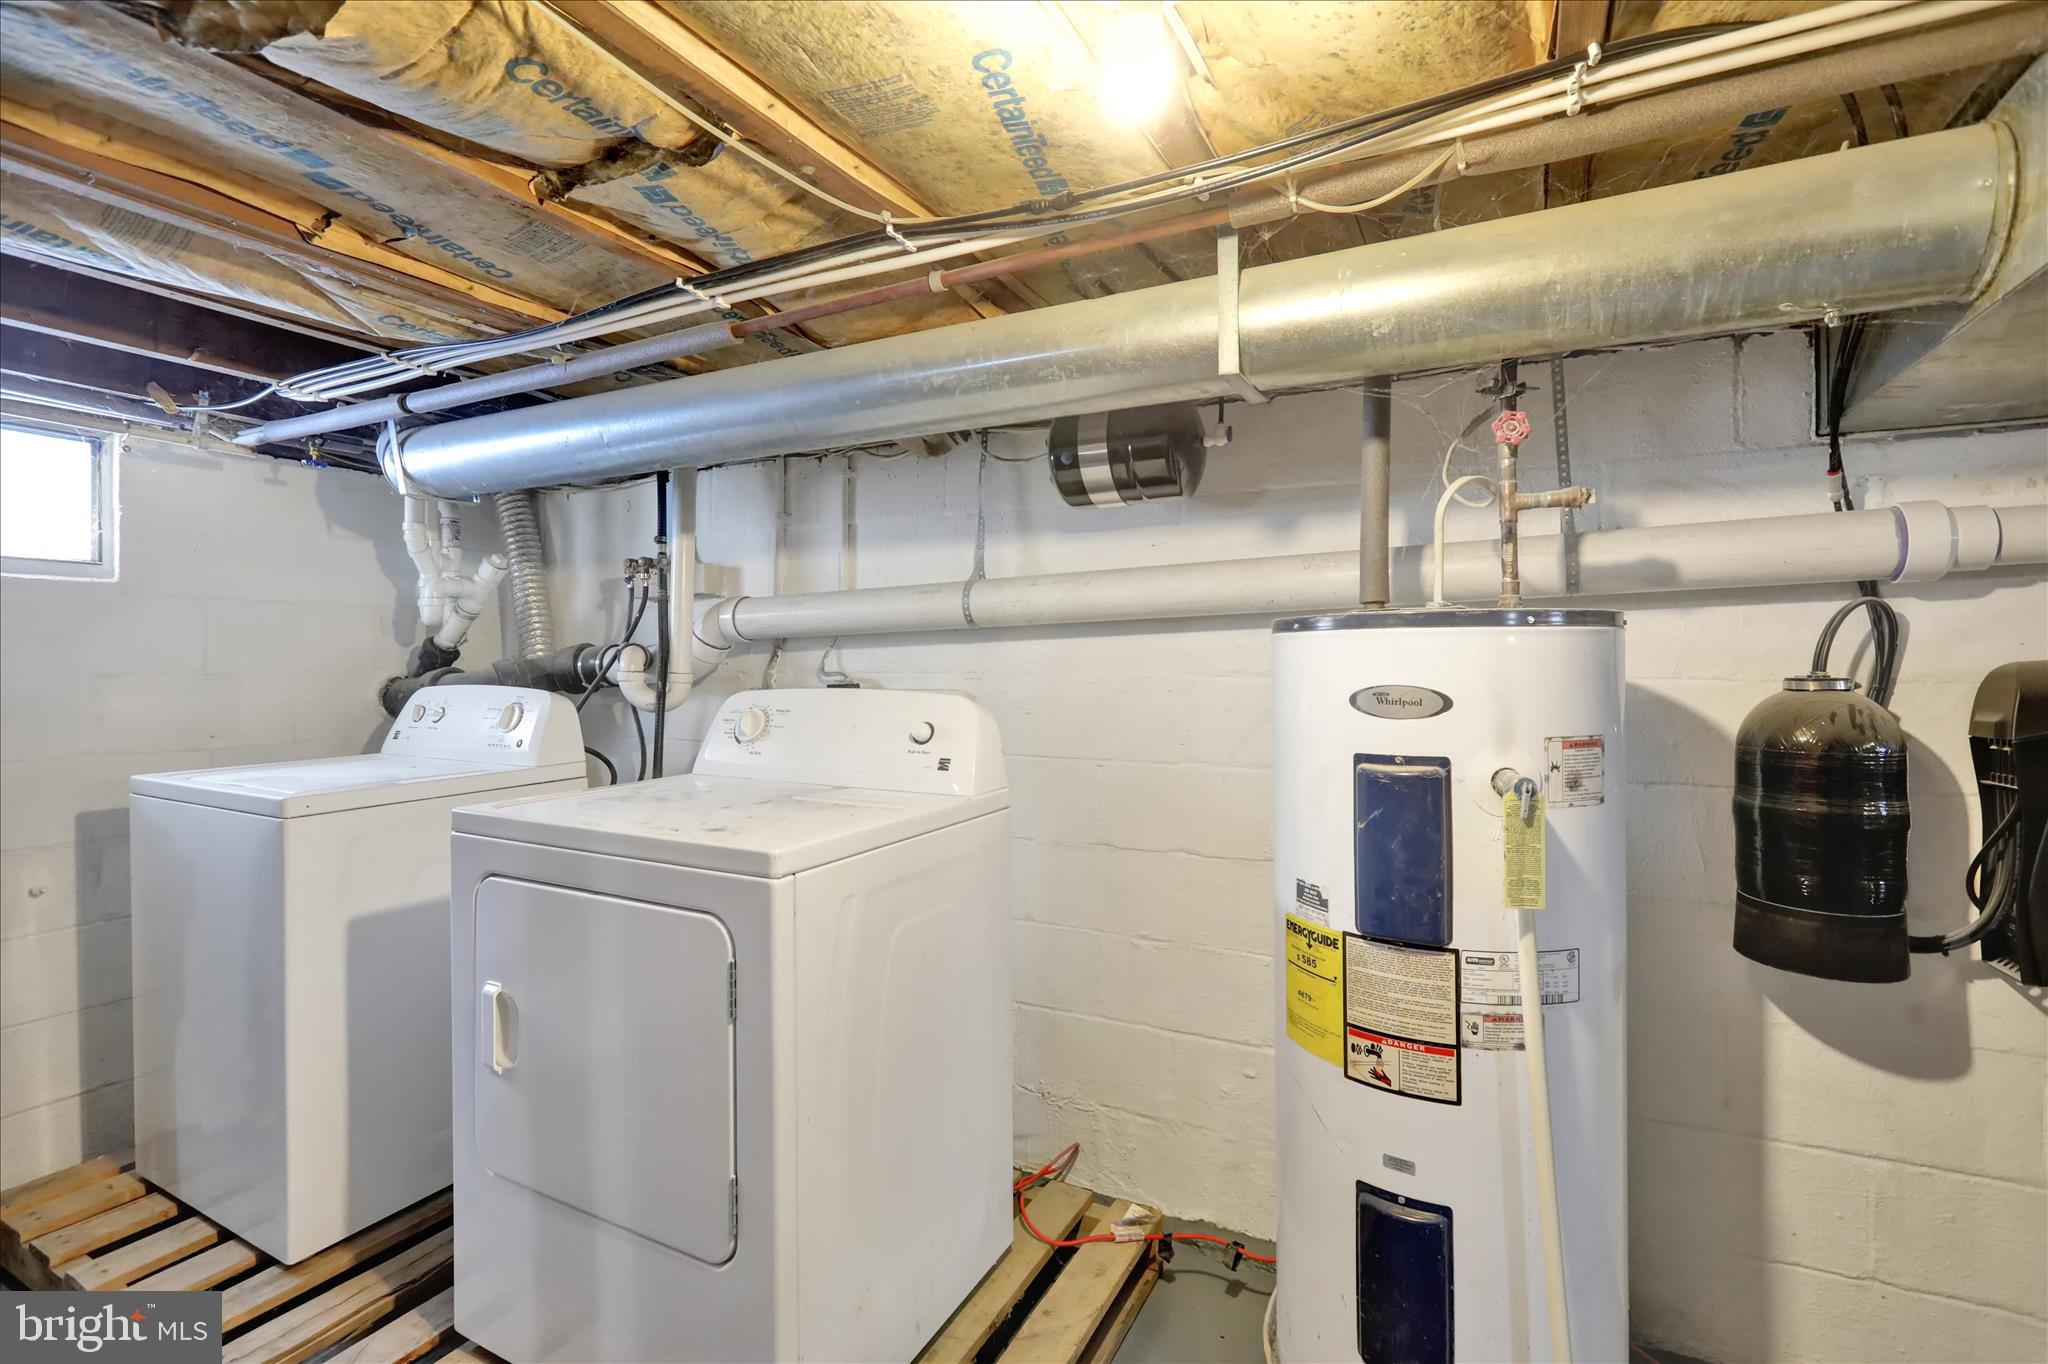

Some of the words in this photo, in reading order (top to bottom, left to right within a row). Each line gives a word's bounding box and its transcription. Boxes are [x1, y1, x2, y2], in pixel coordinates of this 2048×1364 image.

[972, 48, 1063, 180] CertainTeed
[1376, 696, 1422, 708] Whirlpool
[1388, 1040, 1425, 1052] DANGER
